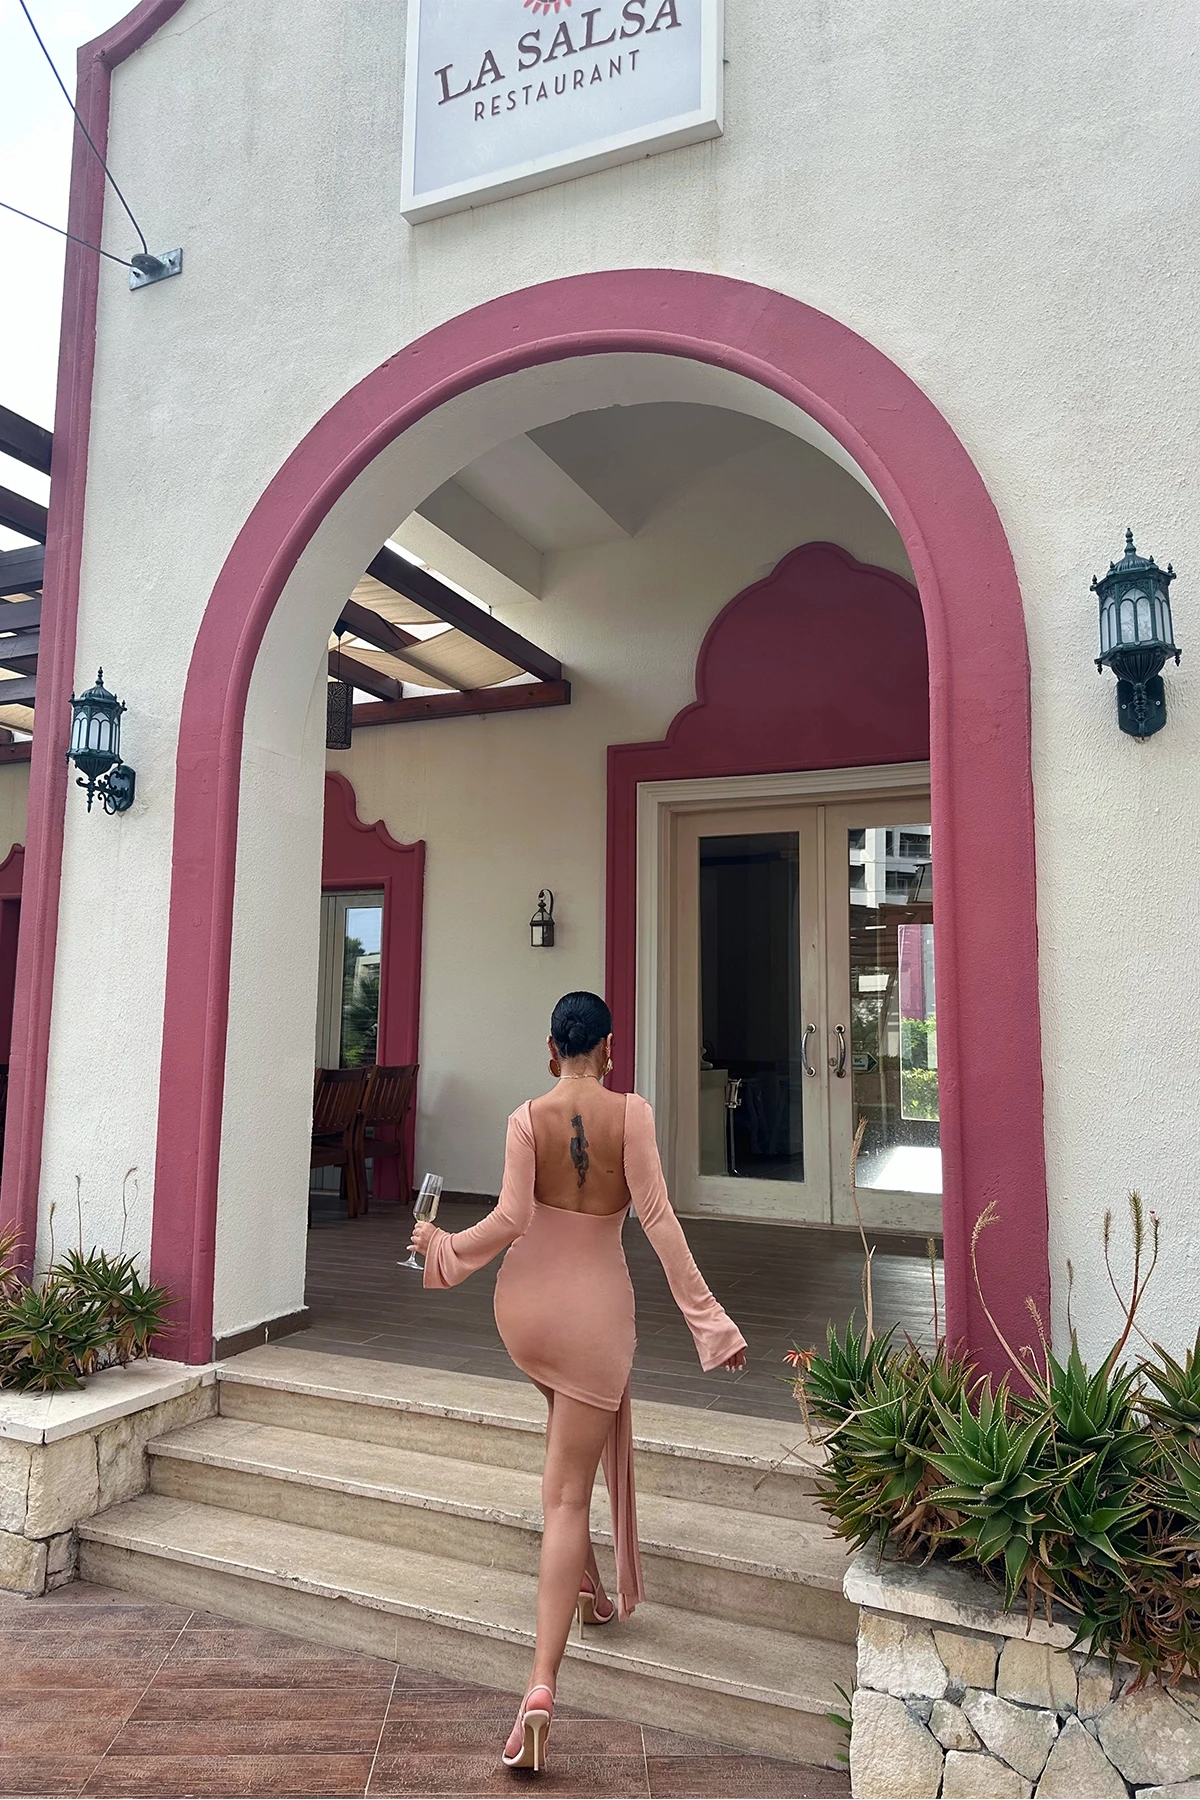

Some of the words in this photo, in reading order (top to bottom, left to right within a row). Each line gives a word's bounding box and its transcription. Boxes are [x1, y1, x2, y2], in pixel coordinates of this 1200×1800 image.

[434, 50, 505, 106] LA
[517, 0, 682, 71] SALSA
[474, 49, 640, 121] RESTAURANT
